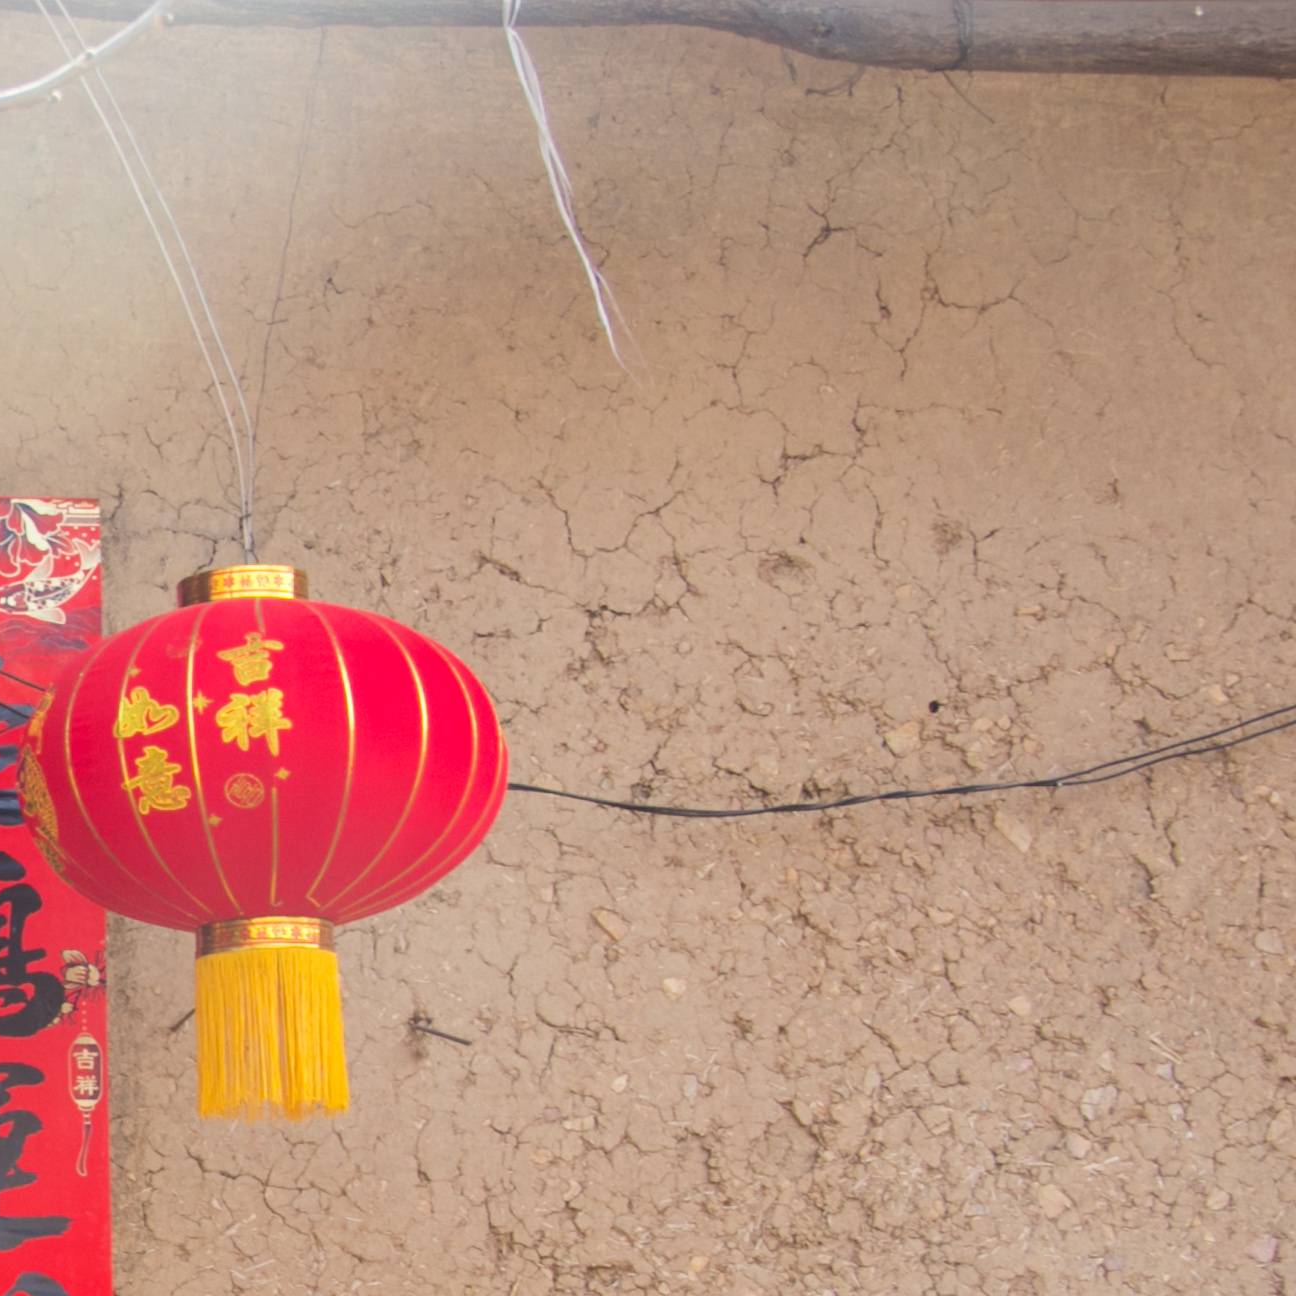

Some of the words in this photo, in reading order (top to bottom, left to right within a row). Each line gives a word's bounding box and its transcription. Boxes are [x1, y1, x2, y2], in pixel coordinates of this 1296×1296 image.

[113, 686, 192, 815] 如意
[215, 632, 292, 756] 吉祥
[72, 1047, 99, 1096] 吉祥
